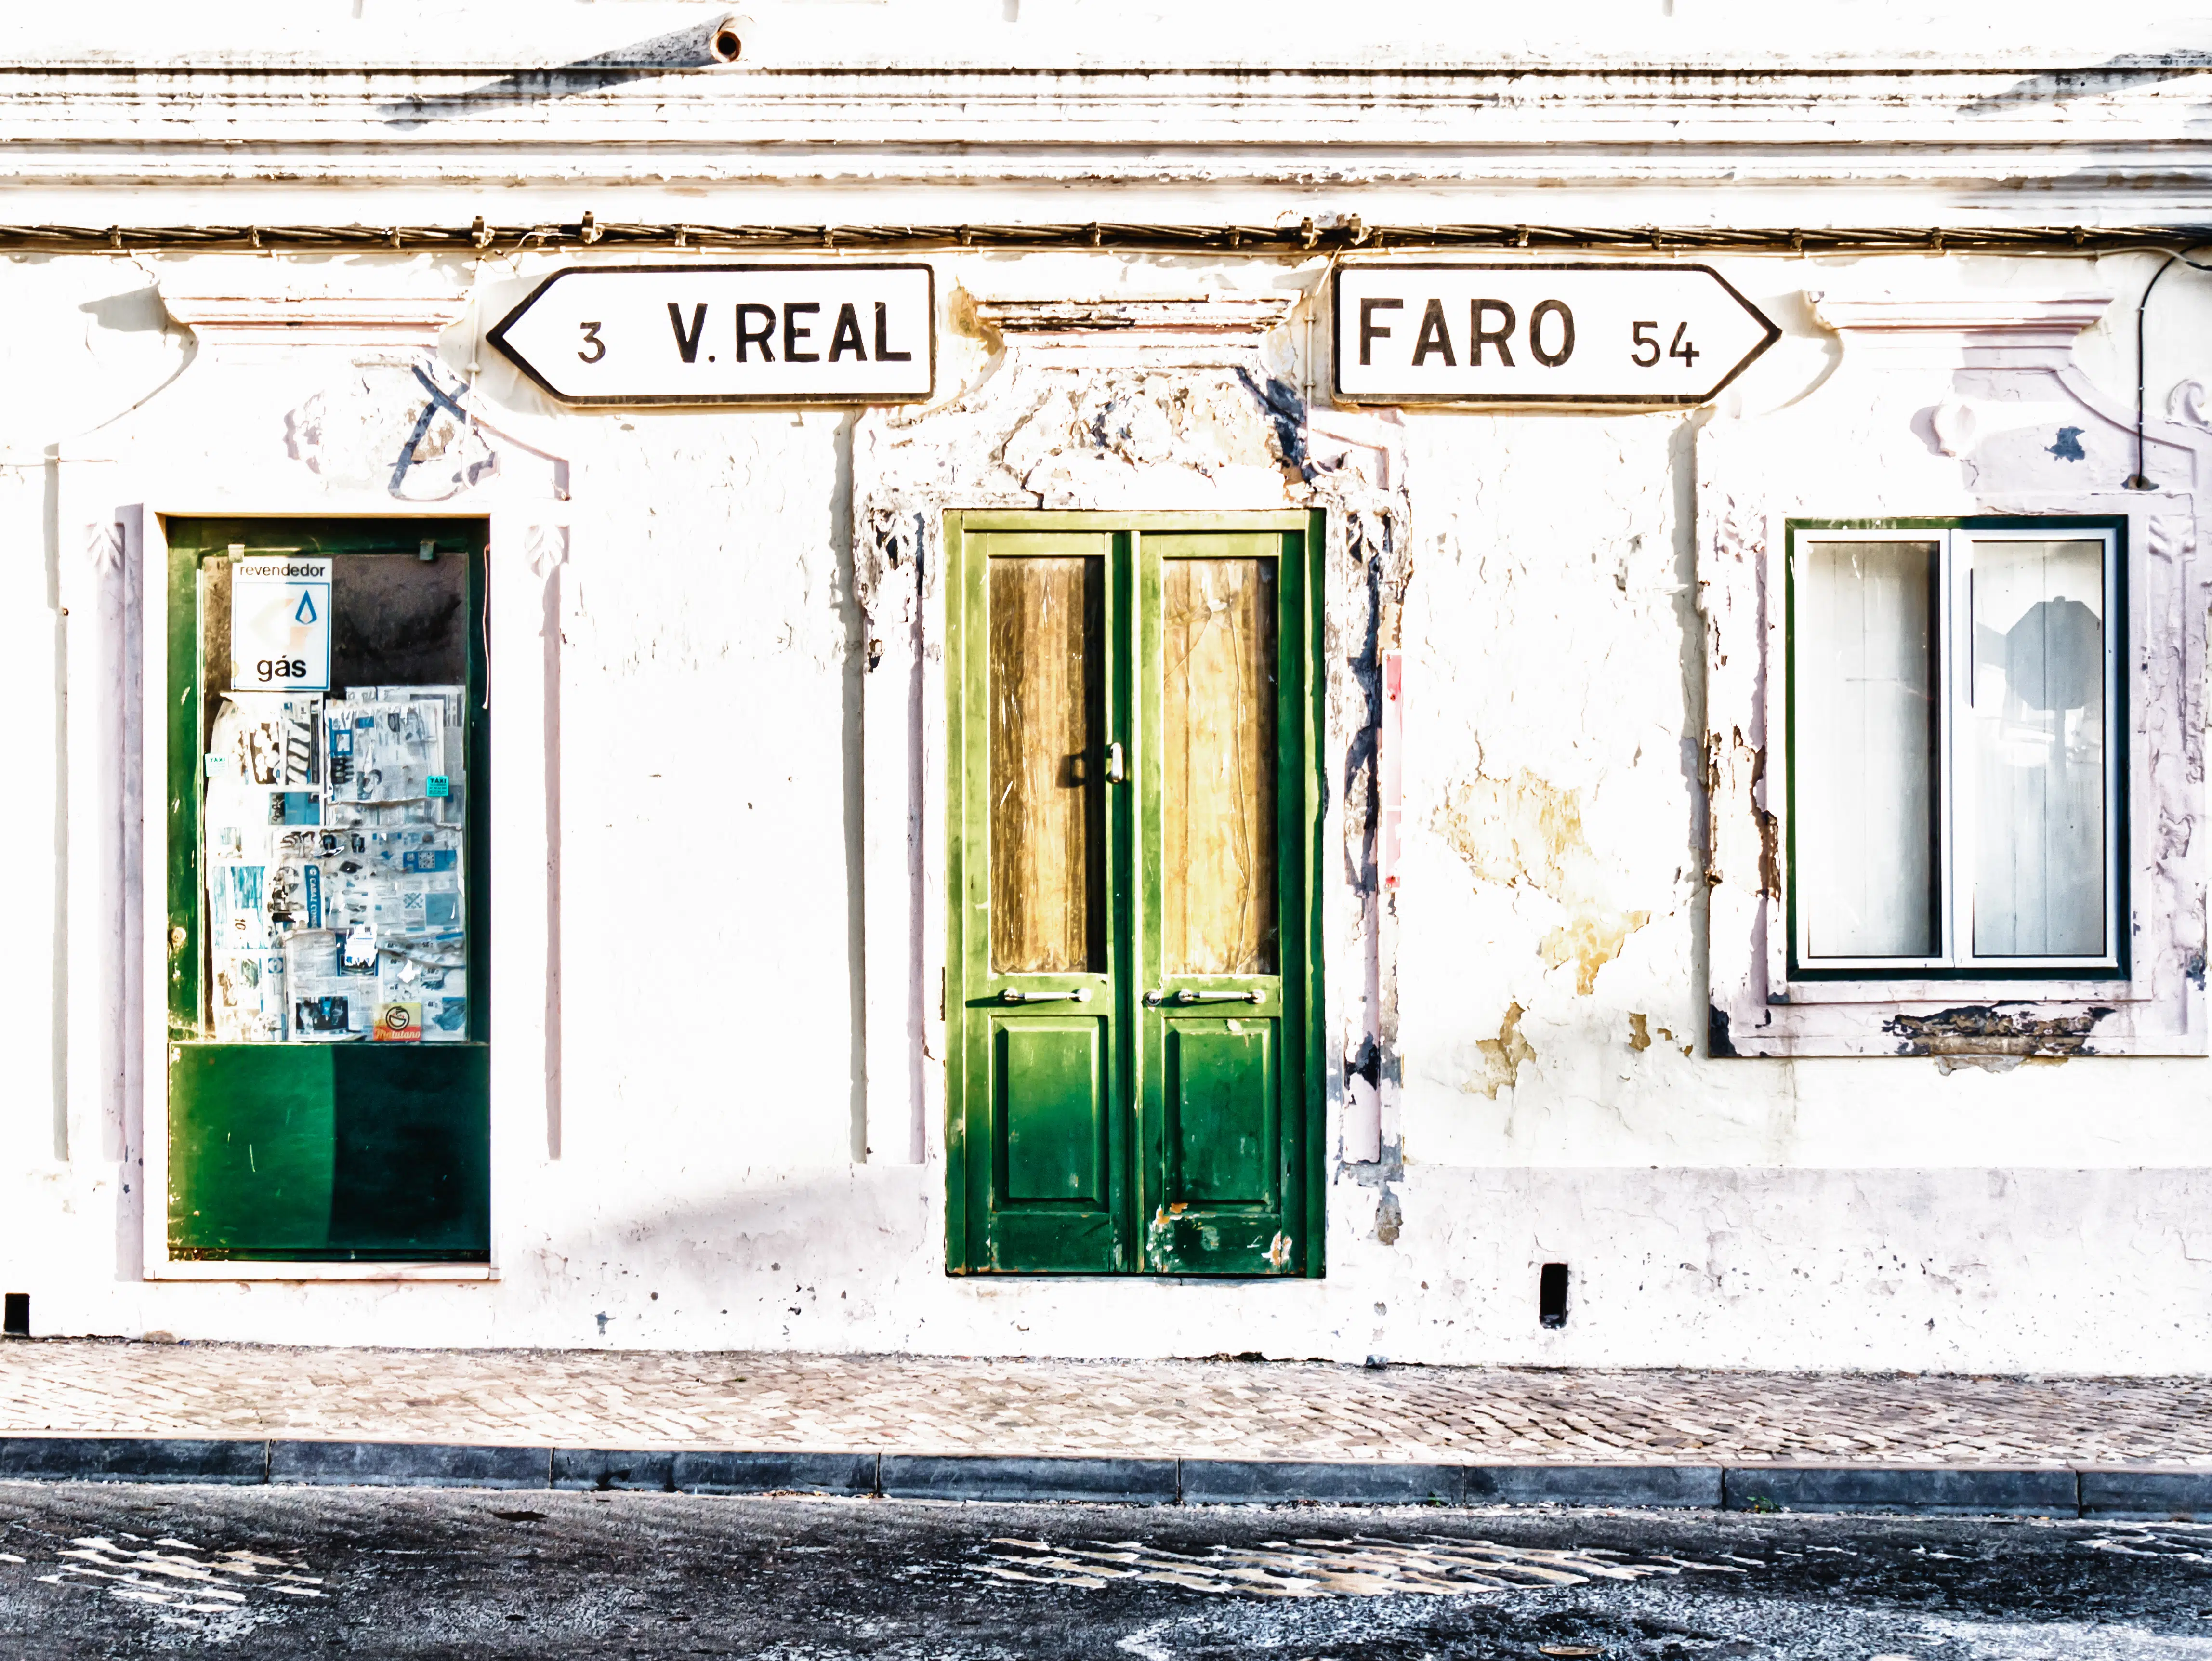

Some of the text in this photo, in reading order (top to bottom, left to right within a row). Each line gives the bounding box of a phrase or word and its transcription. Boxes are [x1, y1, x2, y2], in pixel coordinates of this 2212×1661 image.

[578, 322, 606, 364] 3
[1359, 298, 1700, 368] FARO 54
[240, 563, 326, 577] revendedor
[257, 655, 307, 682] gás
